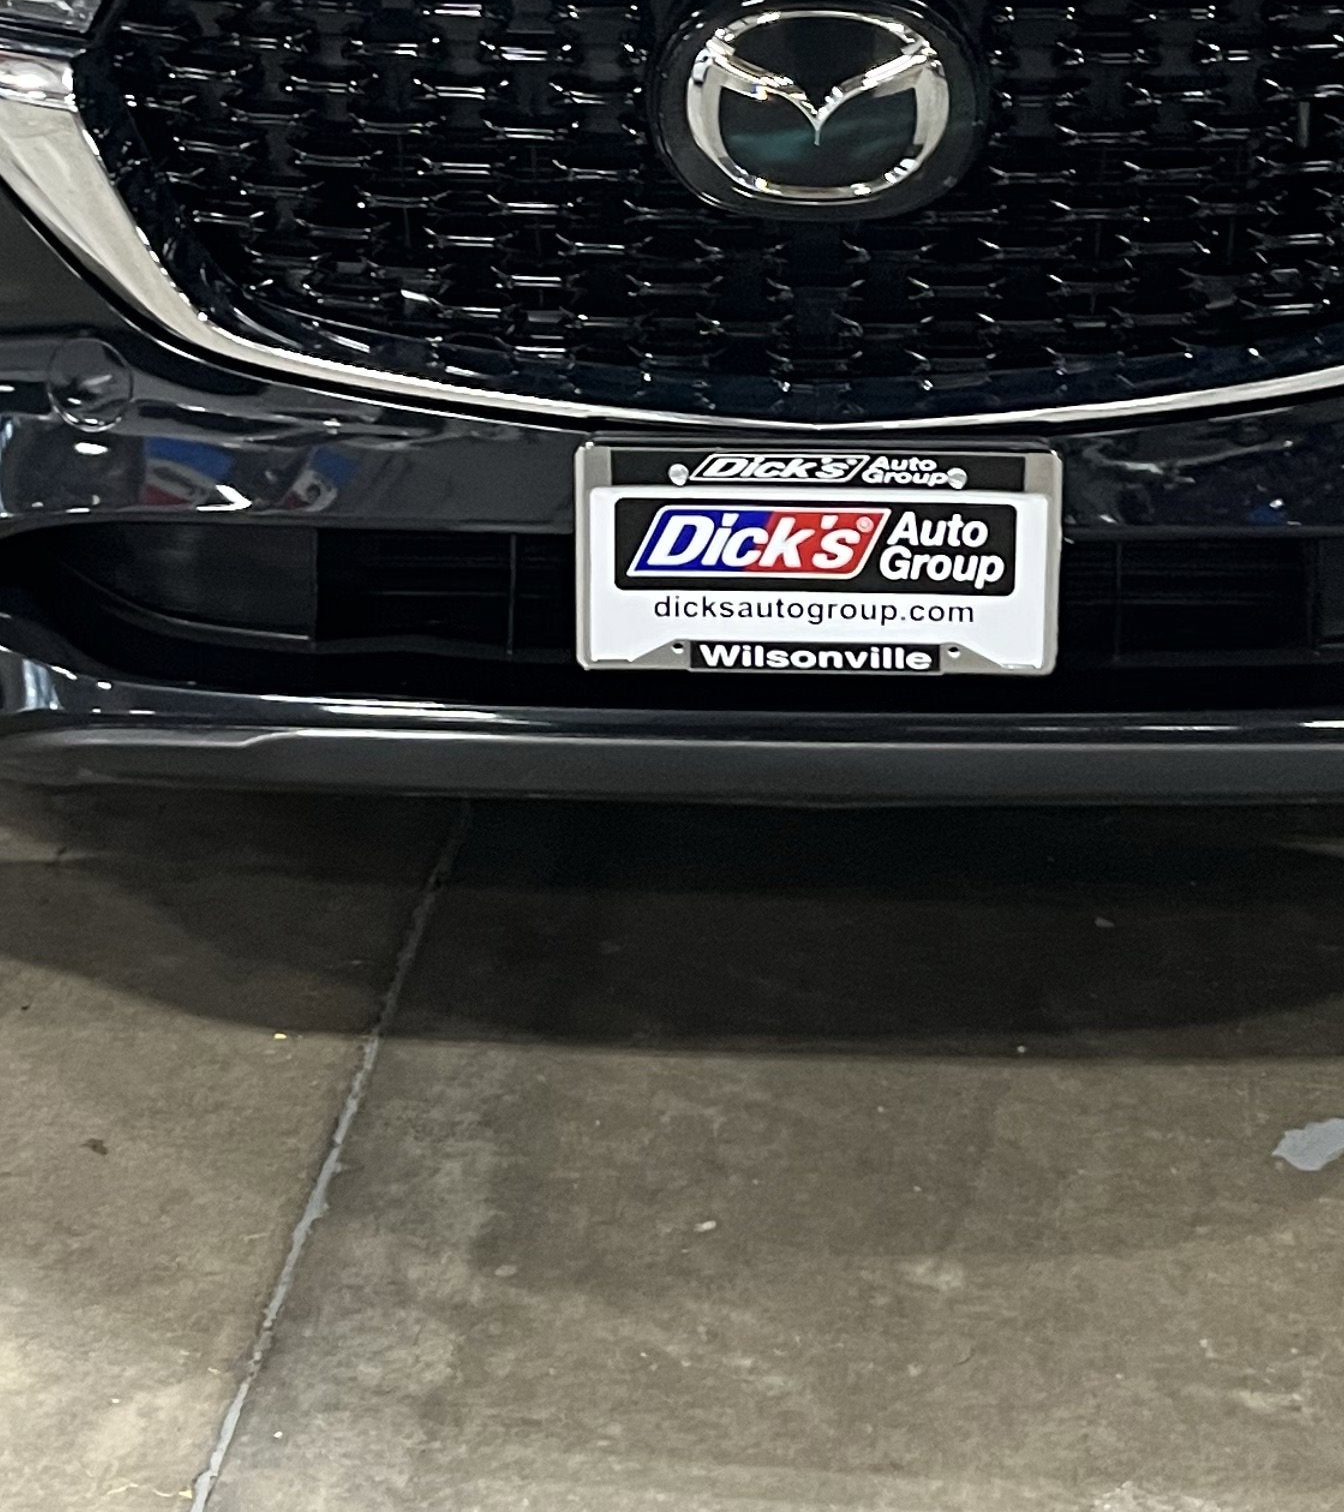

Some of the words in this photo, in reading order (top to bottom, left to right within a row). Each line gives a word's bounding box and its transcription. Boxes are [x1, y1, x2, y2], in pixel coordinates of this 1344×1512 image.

[860, 468, 950, 487] Group
[869, 455, 938, 472] Auto
[886, 510, 989, 548] Auto
[878, 545, 1006, 590] Group
[653, 594, 975, 625] dicksautogroup.com
[699, 643, 933, 671] Wilsonville
